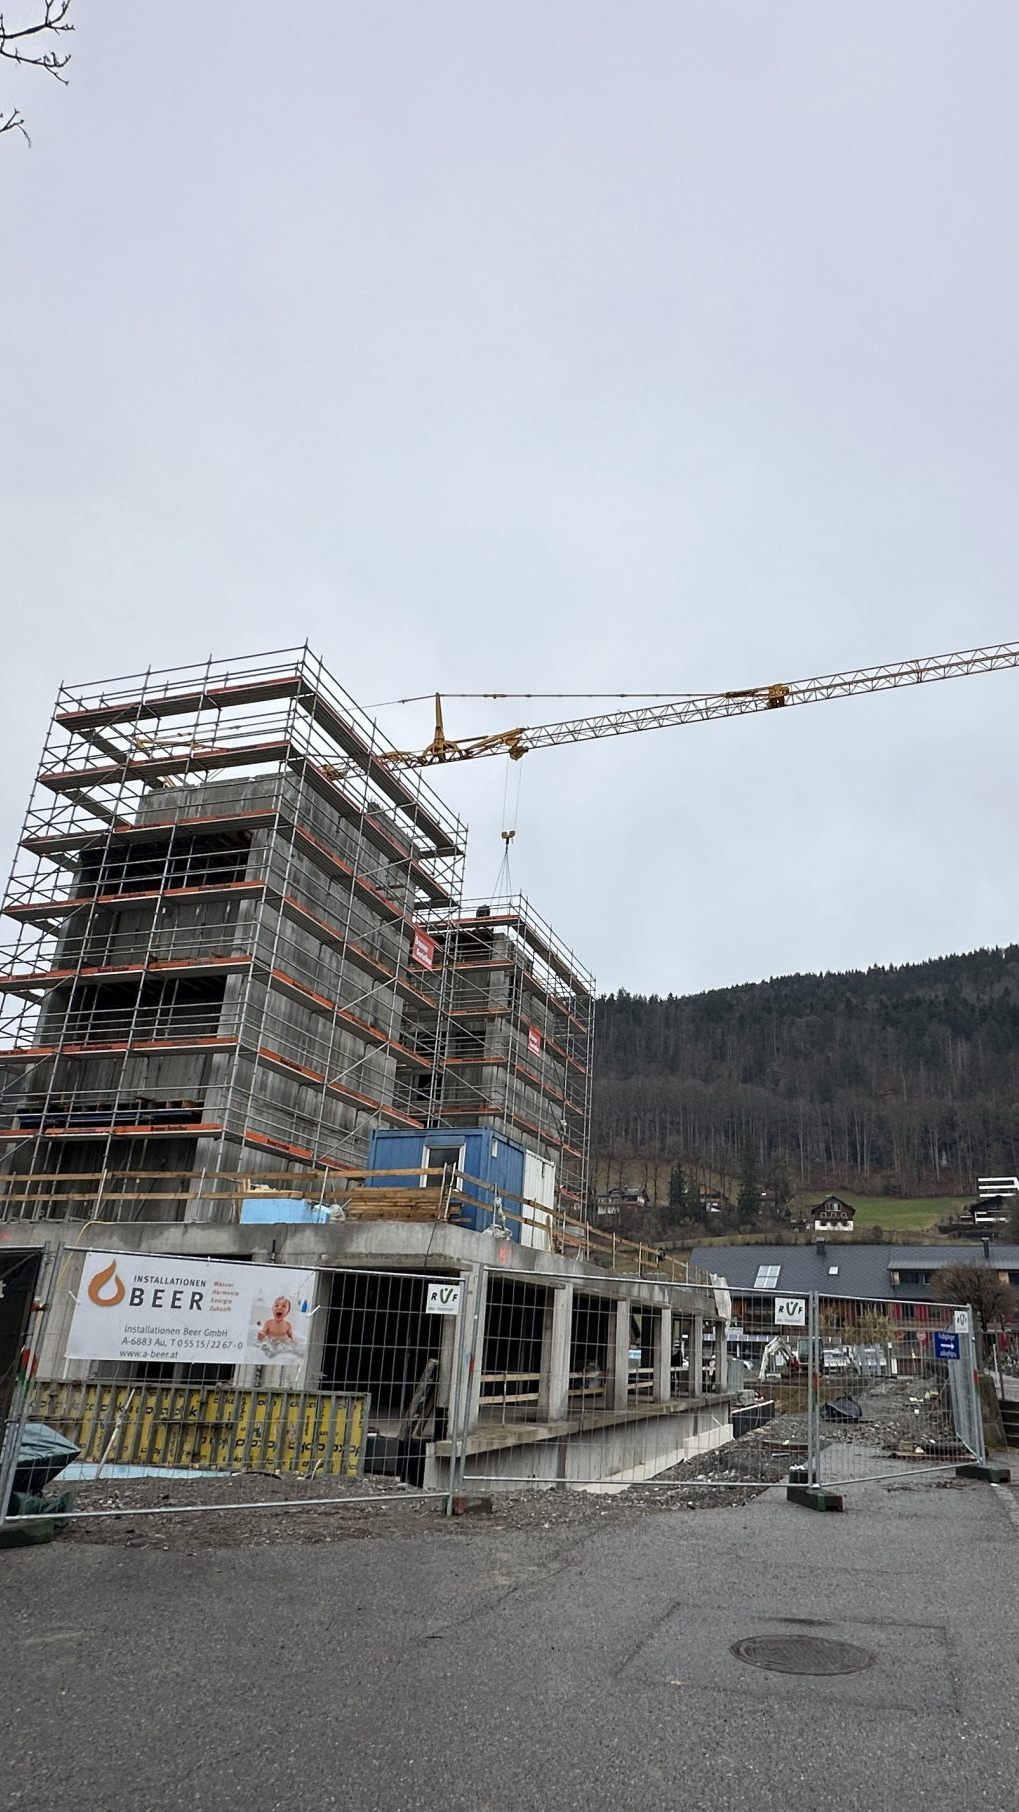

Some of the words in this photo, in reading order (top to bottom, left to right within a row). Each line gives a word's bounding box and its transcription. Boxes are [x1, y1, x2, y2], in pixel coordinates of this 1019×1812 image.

[133, 1274, 207, 1287] INSTALLATIONEN
[129, 1287, 204, 1311] BEER
[124, 1325, 180, 1335] Installationen
[183, 1327, 202, 1336] Beer
[204, 1328, 228, 1338] GmbH
[121, 1336, 152, 1346] A-6883
[119, 1349, 179, 1359] www.a-beer.at
